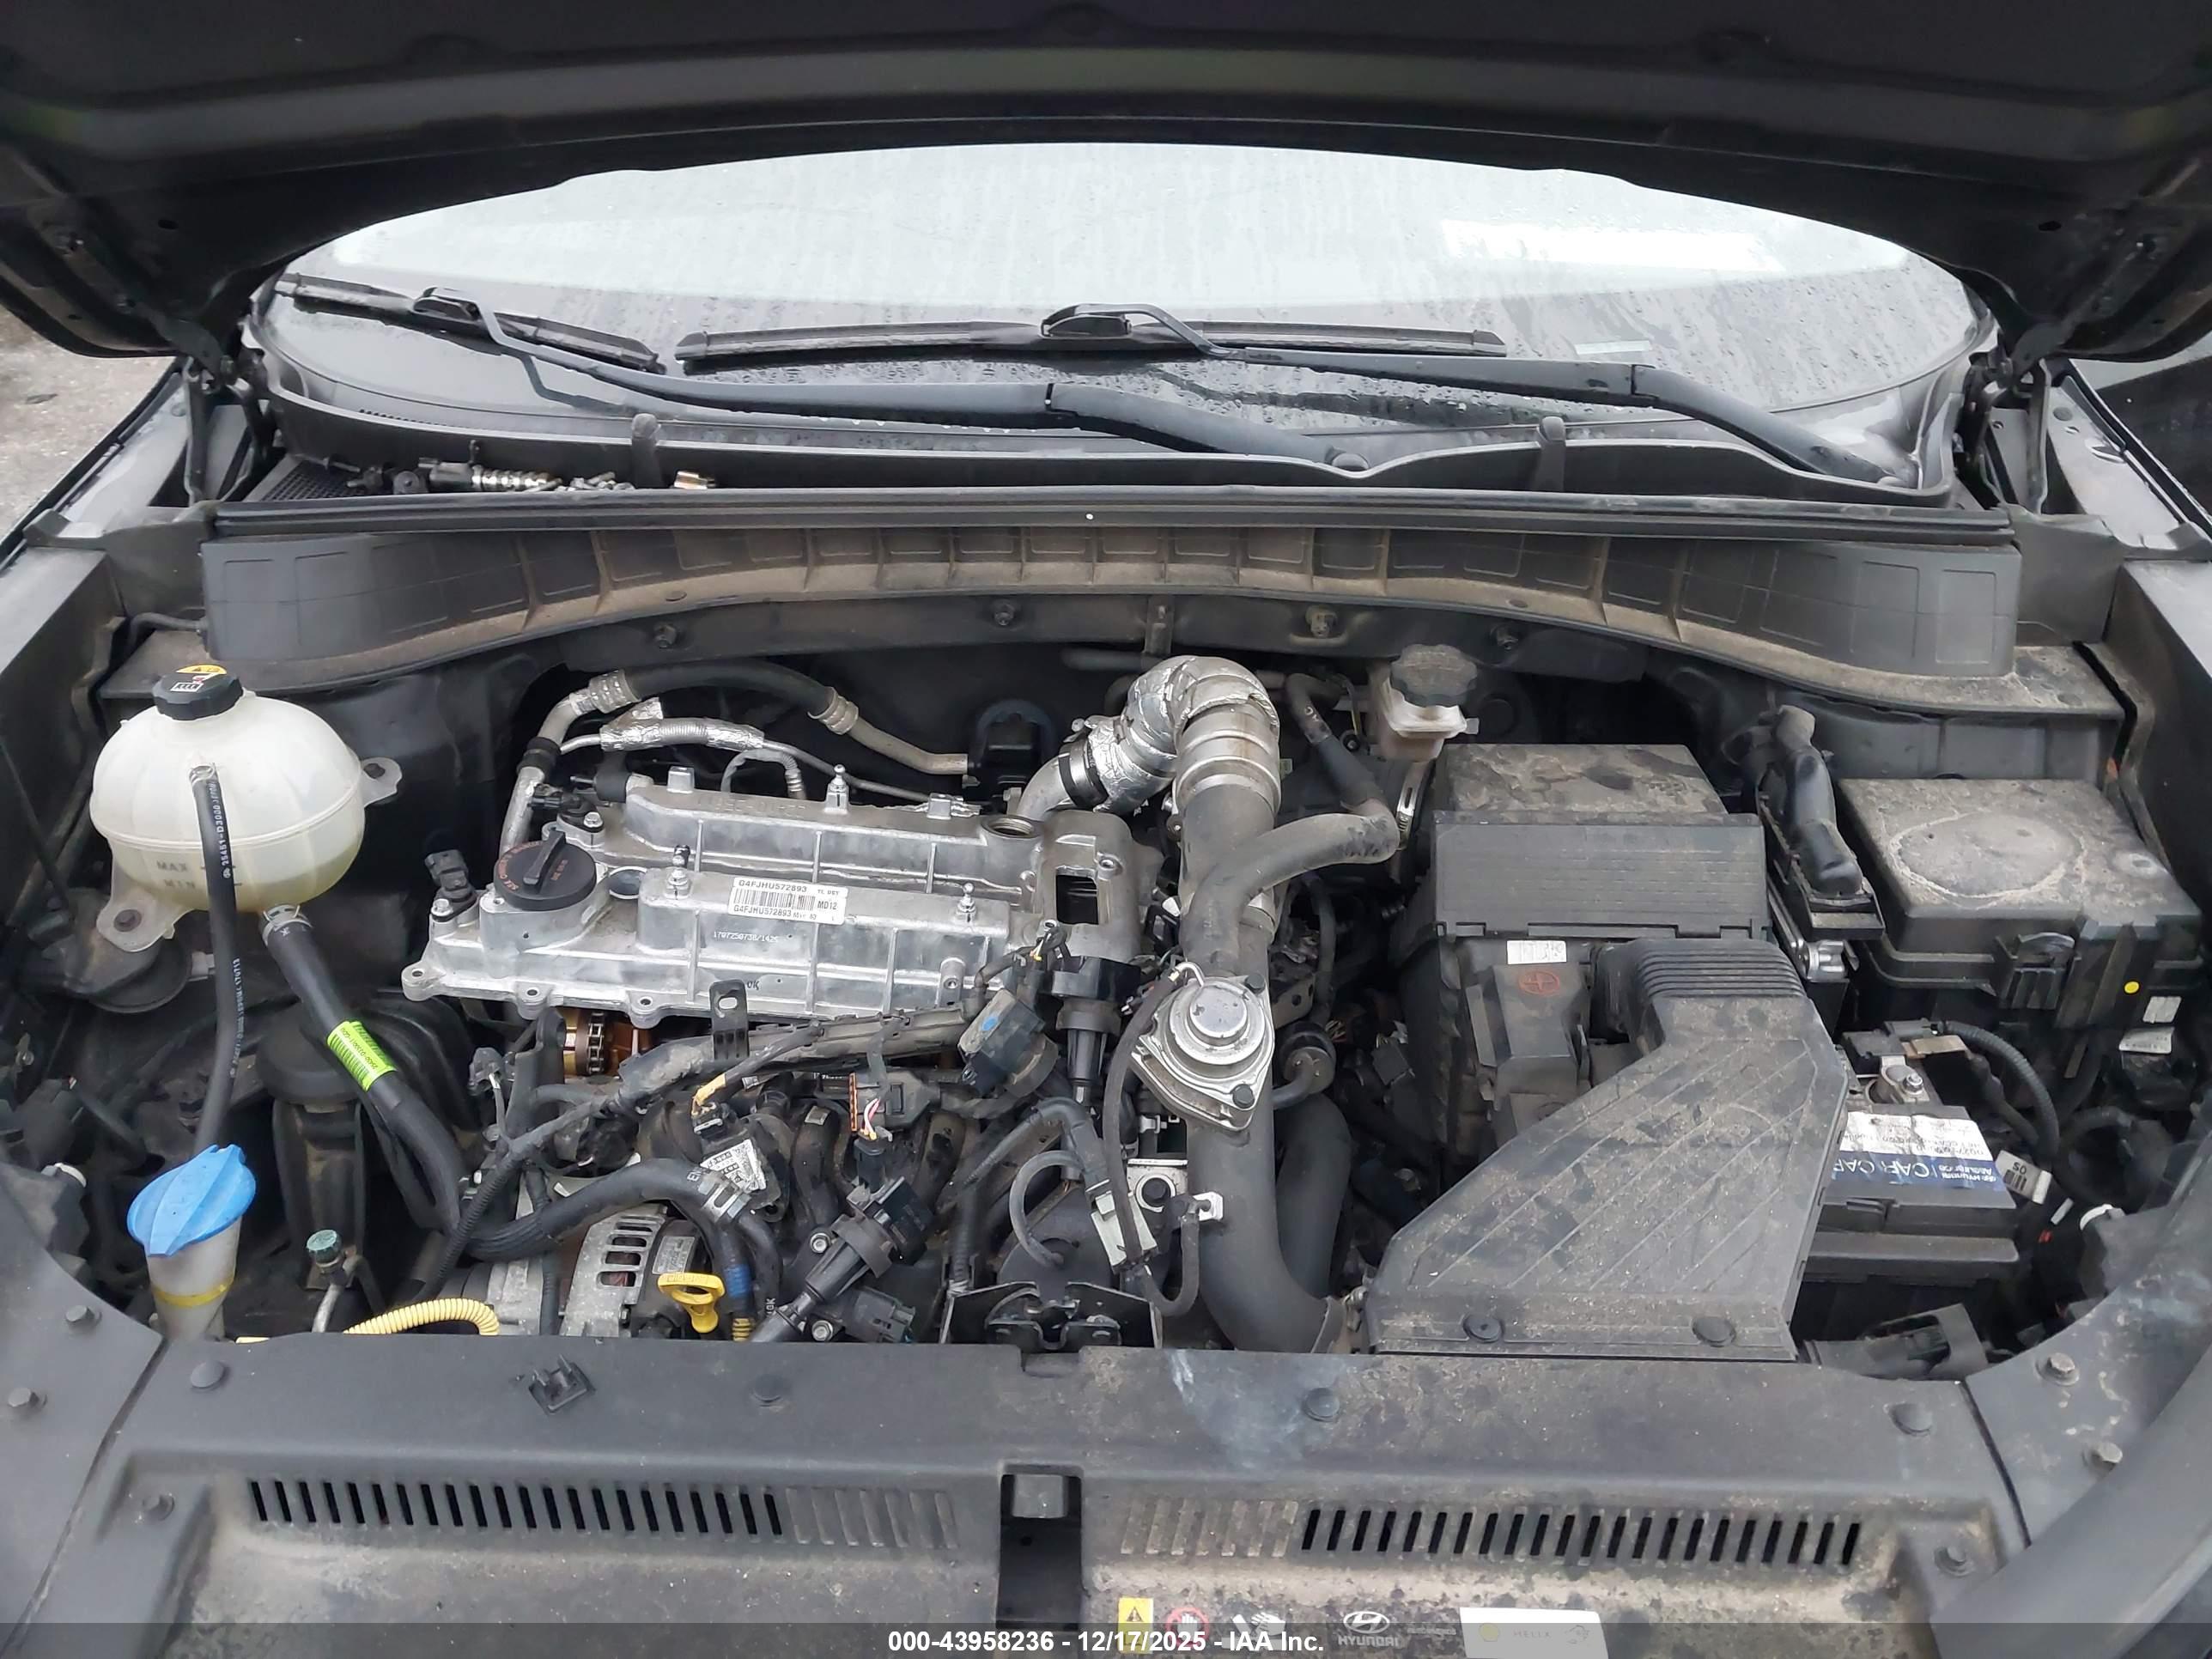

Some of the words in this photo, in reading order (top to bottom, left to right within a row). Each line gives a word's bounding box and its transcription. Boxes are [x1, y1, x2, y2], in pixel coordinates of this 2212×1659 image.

[738, 879, 807, 893] G4FJHU572893
[733, 904, 793, 917] G4FJHU572893
[1338, 1635, 1399, 1647] HYUNDAI
